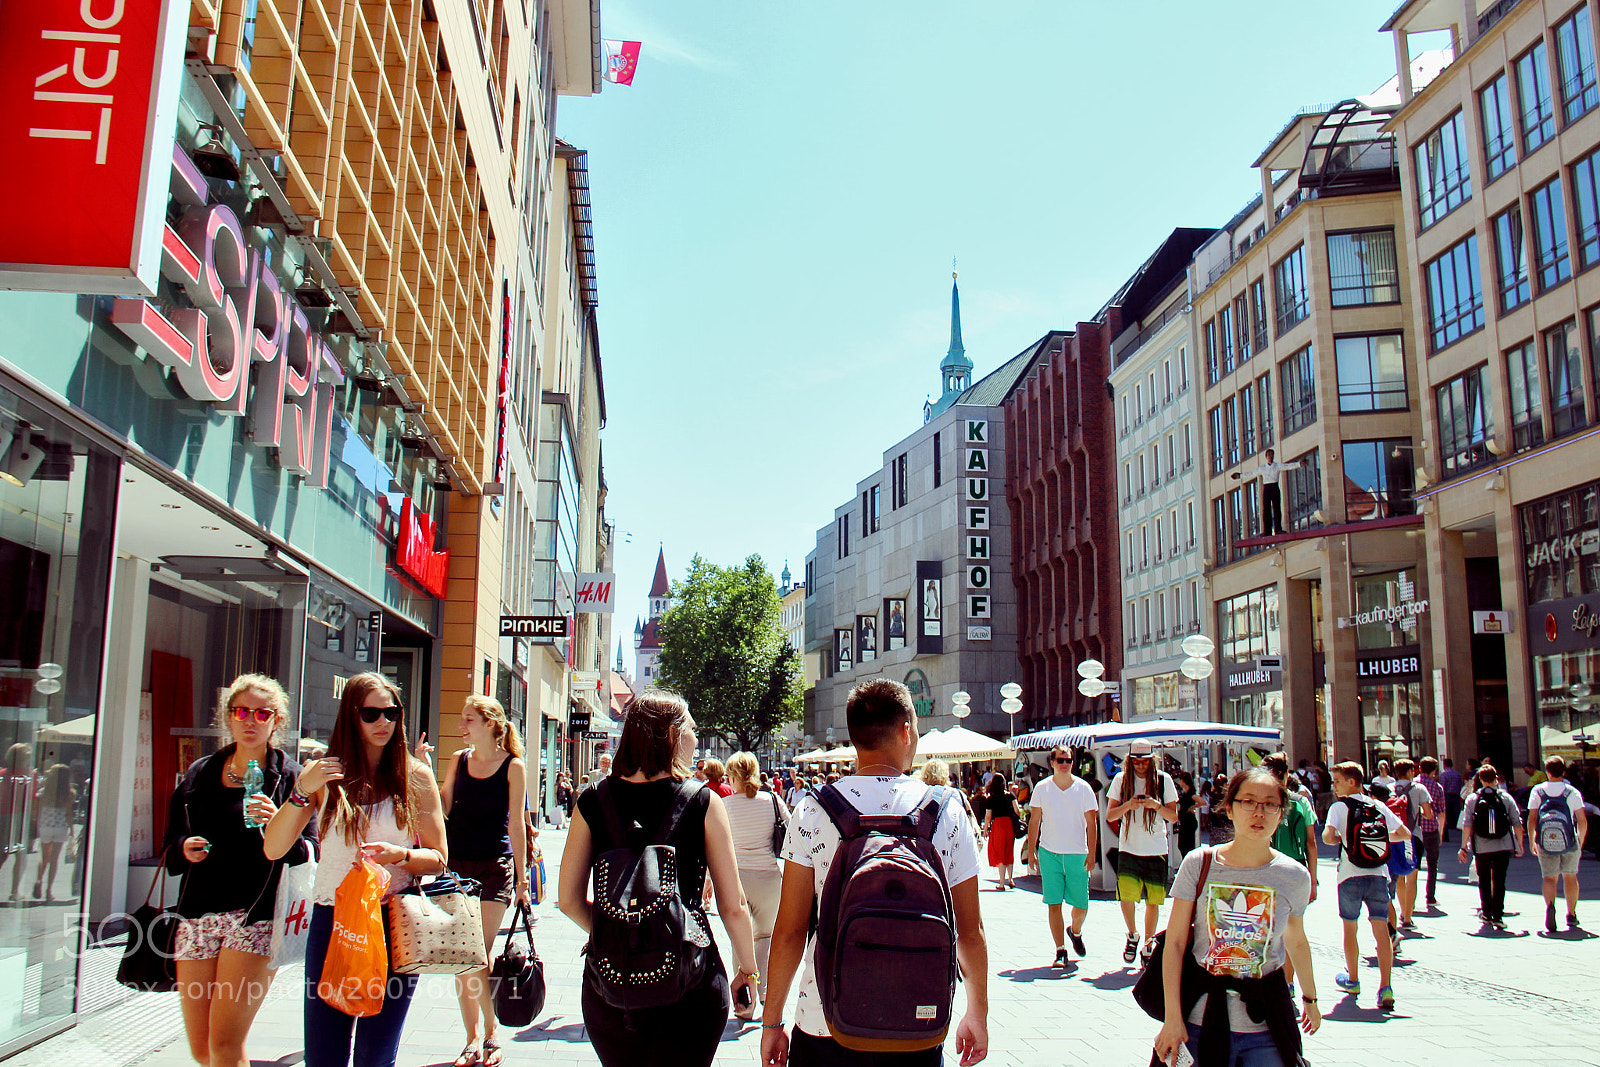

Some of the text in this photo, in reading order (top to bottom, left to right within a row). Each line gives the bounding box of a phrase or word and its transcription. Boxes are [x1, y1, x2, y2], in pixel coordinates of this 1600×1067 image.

[968, 421, 988, 617] KAUFHOF
[1528, 533, 1579, 568] JACK
[577, 582, 611, 604] H&M
[501, 619, 564, 633] PIMKIE
[1356, 657, 1418, 676] LHUBER
[1229, 669, 1271, 687] HALLHUBER
[1214, 926, 1263, 941] adidas
